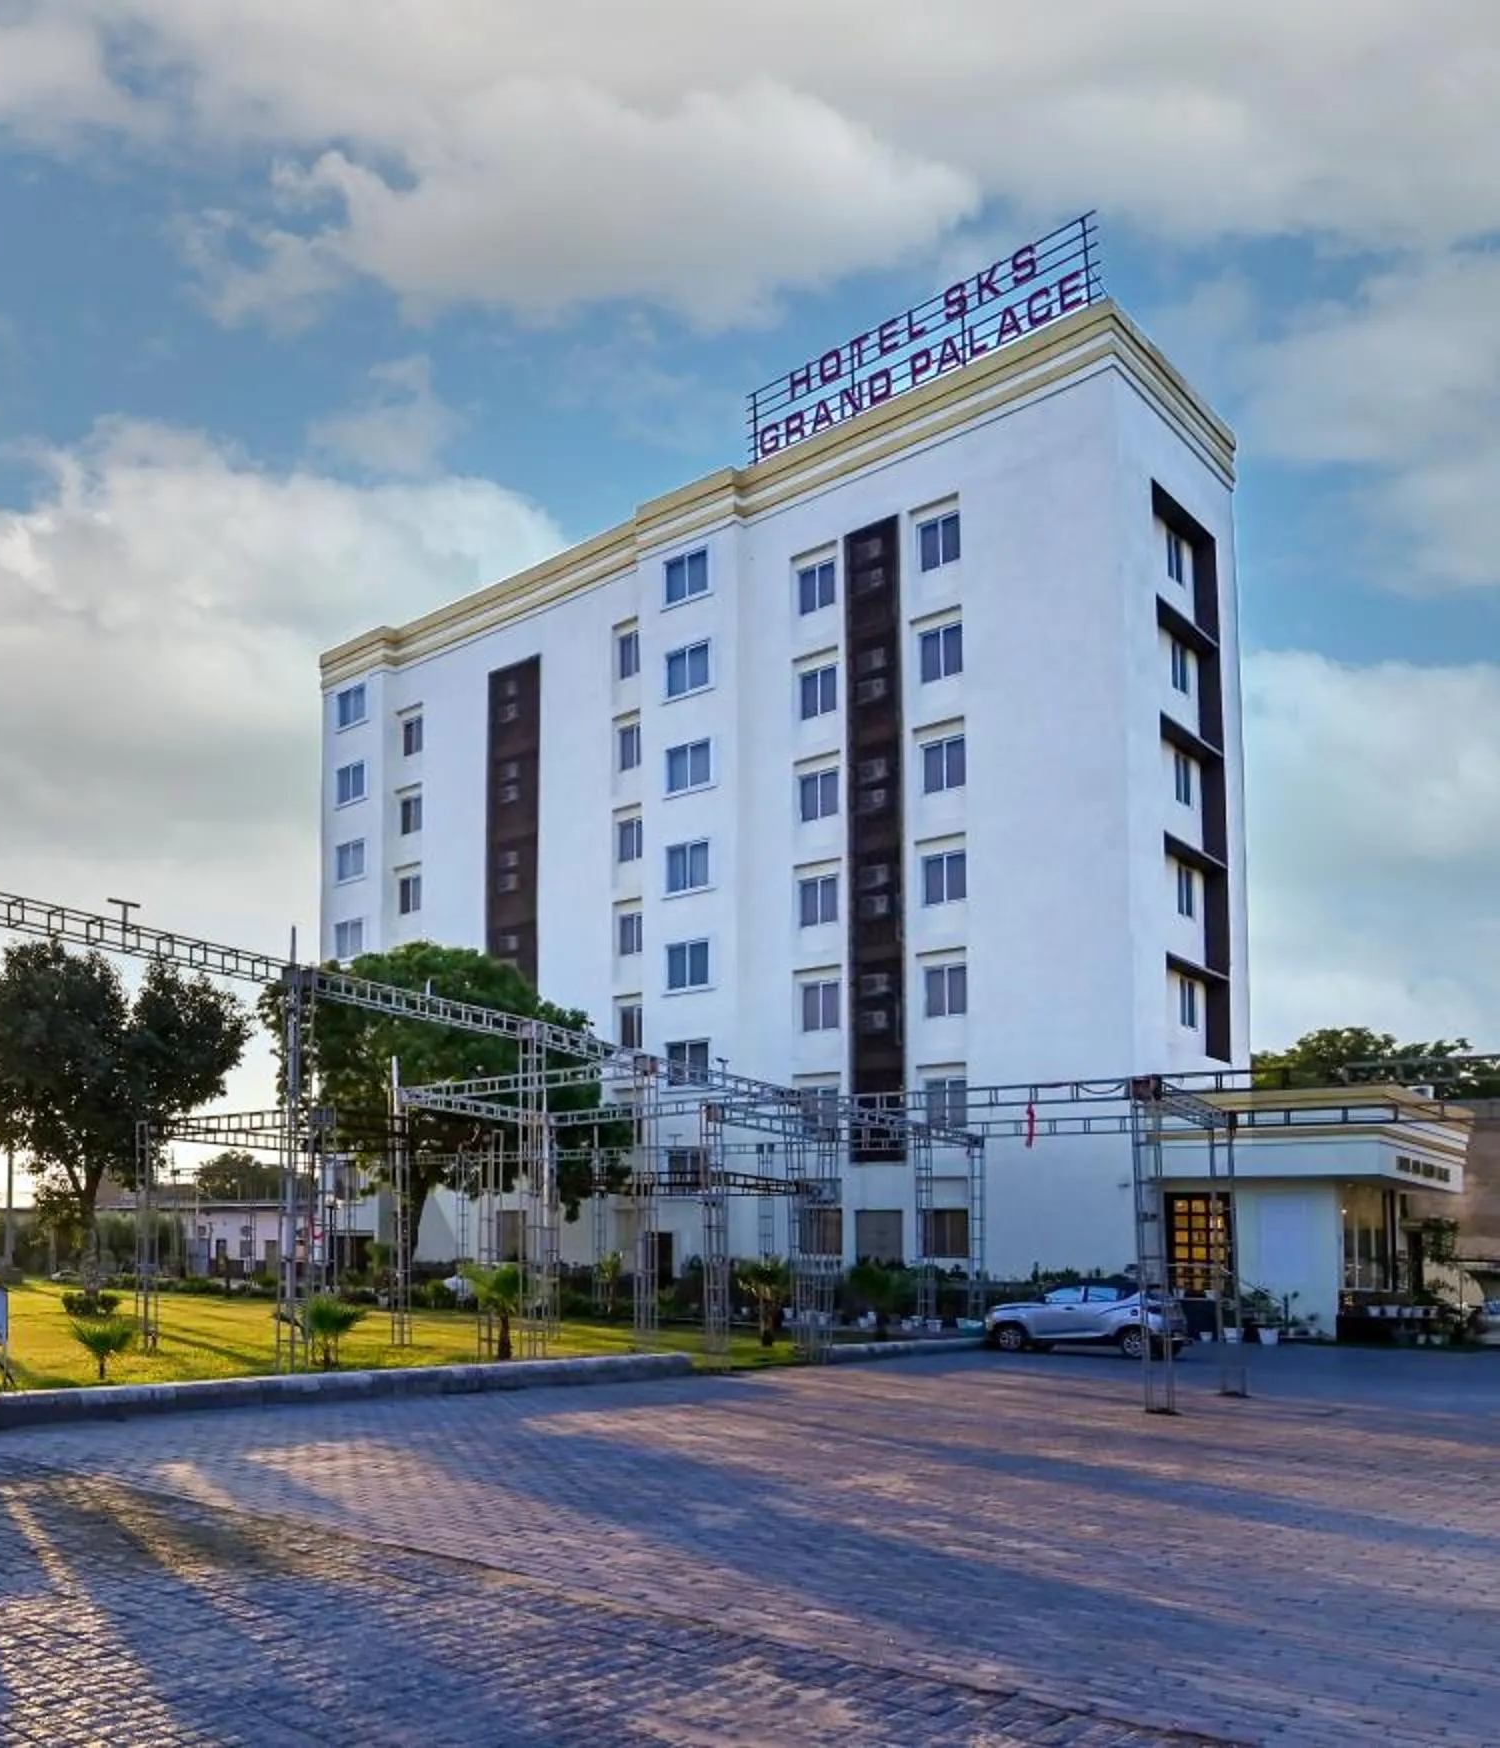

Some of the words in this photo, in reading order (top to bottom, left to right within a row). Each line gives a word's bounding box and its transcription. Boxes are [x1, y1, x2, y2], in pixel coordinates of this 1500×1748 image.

[759, 367, 891, 456] GRAND
[910, 269, 1085, 386] PALACE
[789, 310, 926, 400] HOTEL
[944, 244, 1037, 322] SKS
